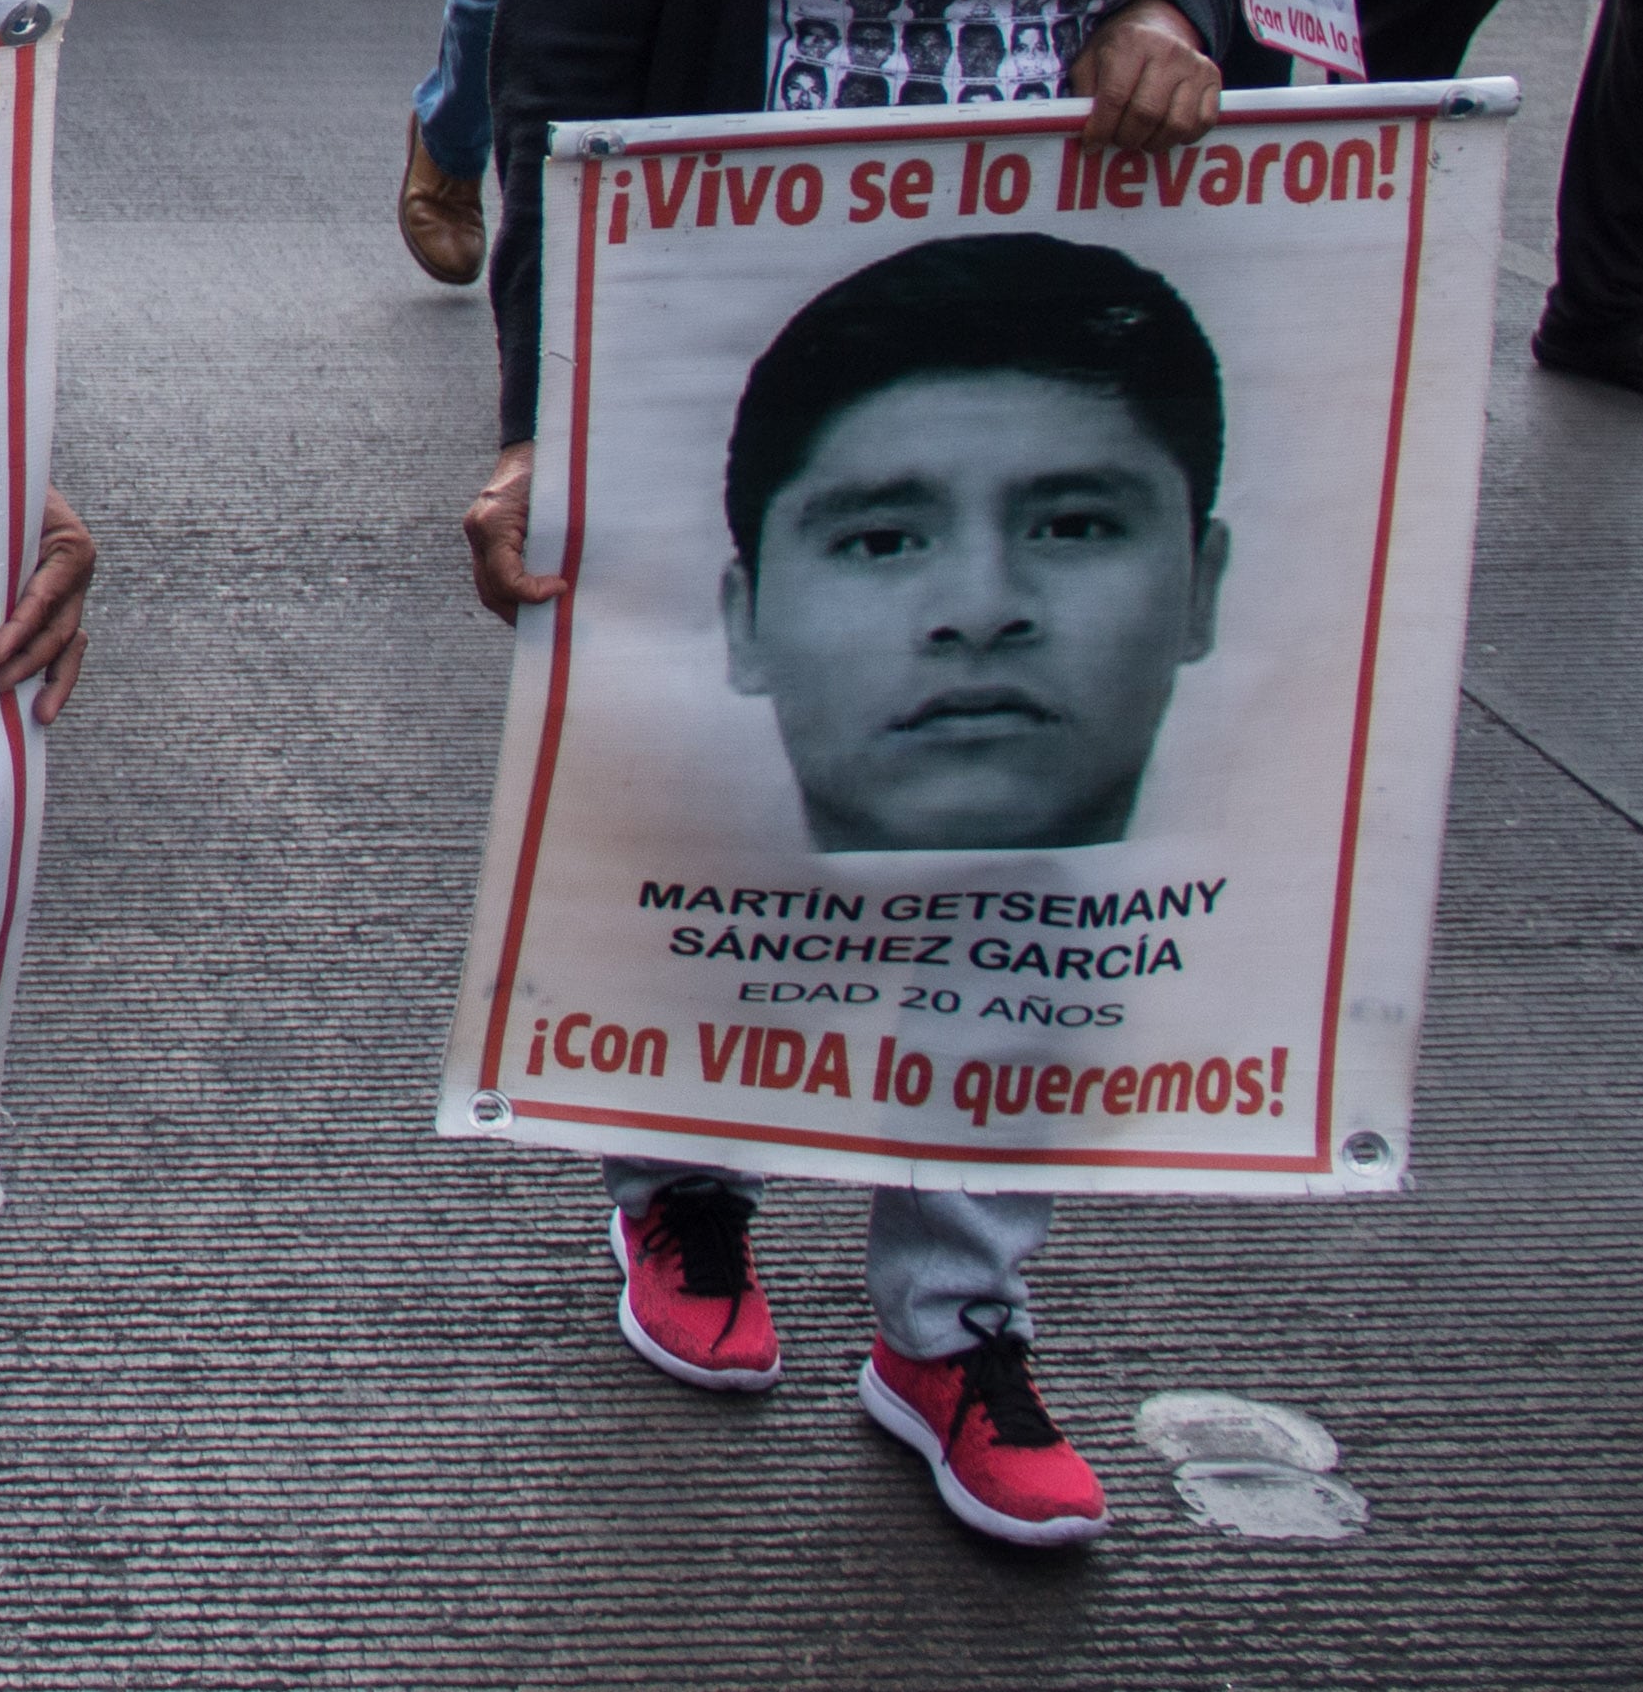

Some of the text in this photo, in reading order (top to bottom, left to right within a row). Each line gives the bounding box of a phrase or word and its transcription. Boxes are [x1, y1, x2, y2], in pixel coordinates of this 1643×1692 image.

[1287, 5, 1349, 53] VIDA lo
[606, 122, 1401, 246] ¡Vivo se lo llevaron!
[636, 875, 1228, 930] MARTÍN GETSEMANY
[668, 923, 1185, 978] SÁNCHEZ GARCÍA
[737, 980, 1127, 1030] EDAD 20 AÑOS
[523, 1011, 1291, 1132] ¡Con VIDA lo queremos!
